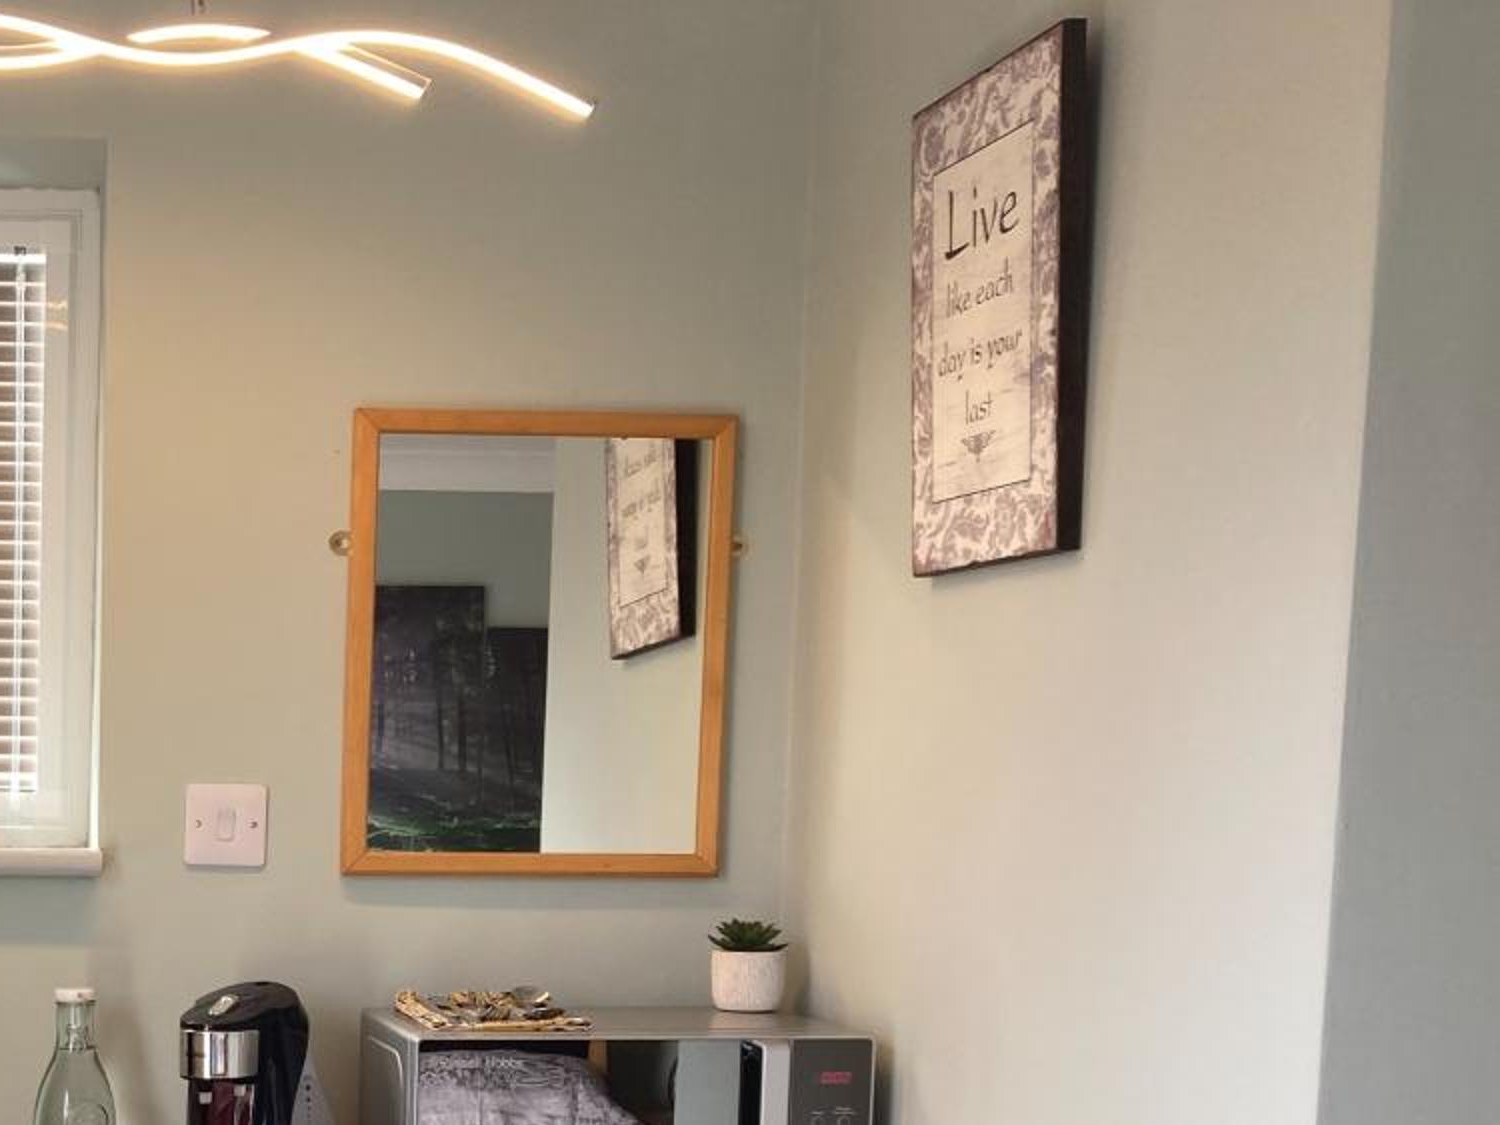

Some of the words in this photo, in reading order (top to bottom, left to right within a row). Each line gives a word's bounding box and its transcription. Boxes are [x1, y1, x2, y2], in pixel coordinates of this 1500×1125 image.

[944, 186, 1020, 260] Live
[976, 256, 1013, 305] each
[938, 341, 967, 381] day
[969, 338, 982, 365] is
[987, 329, 1023, 370] your
[965, 390, 993, 425] last
